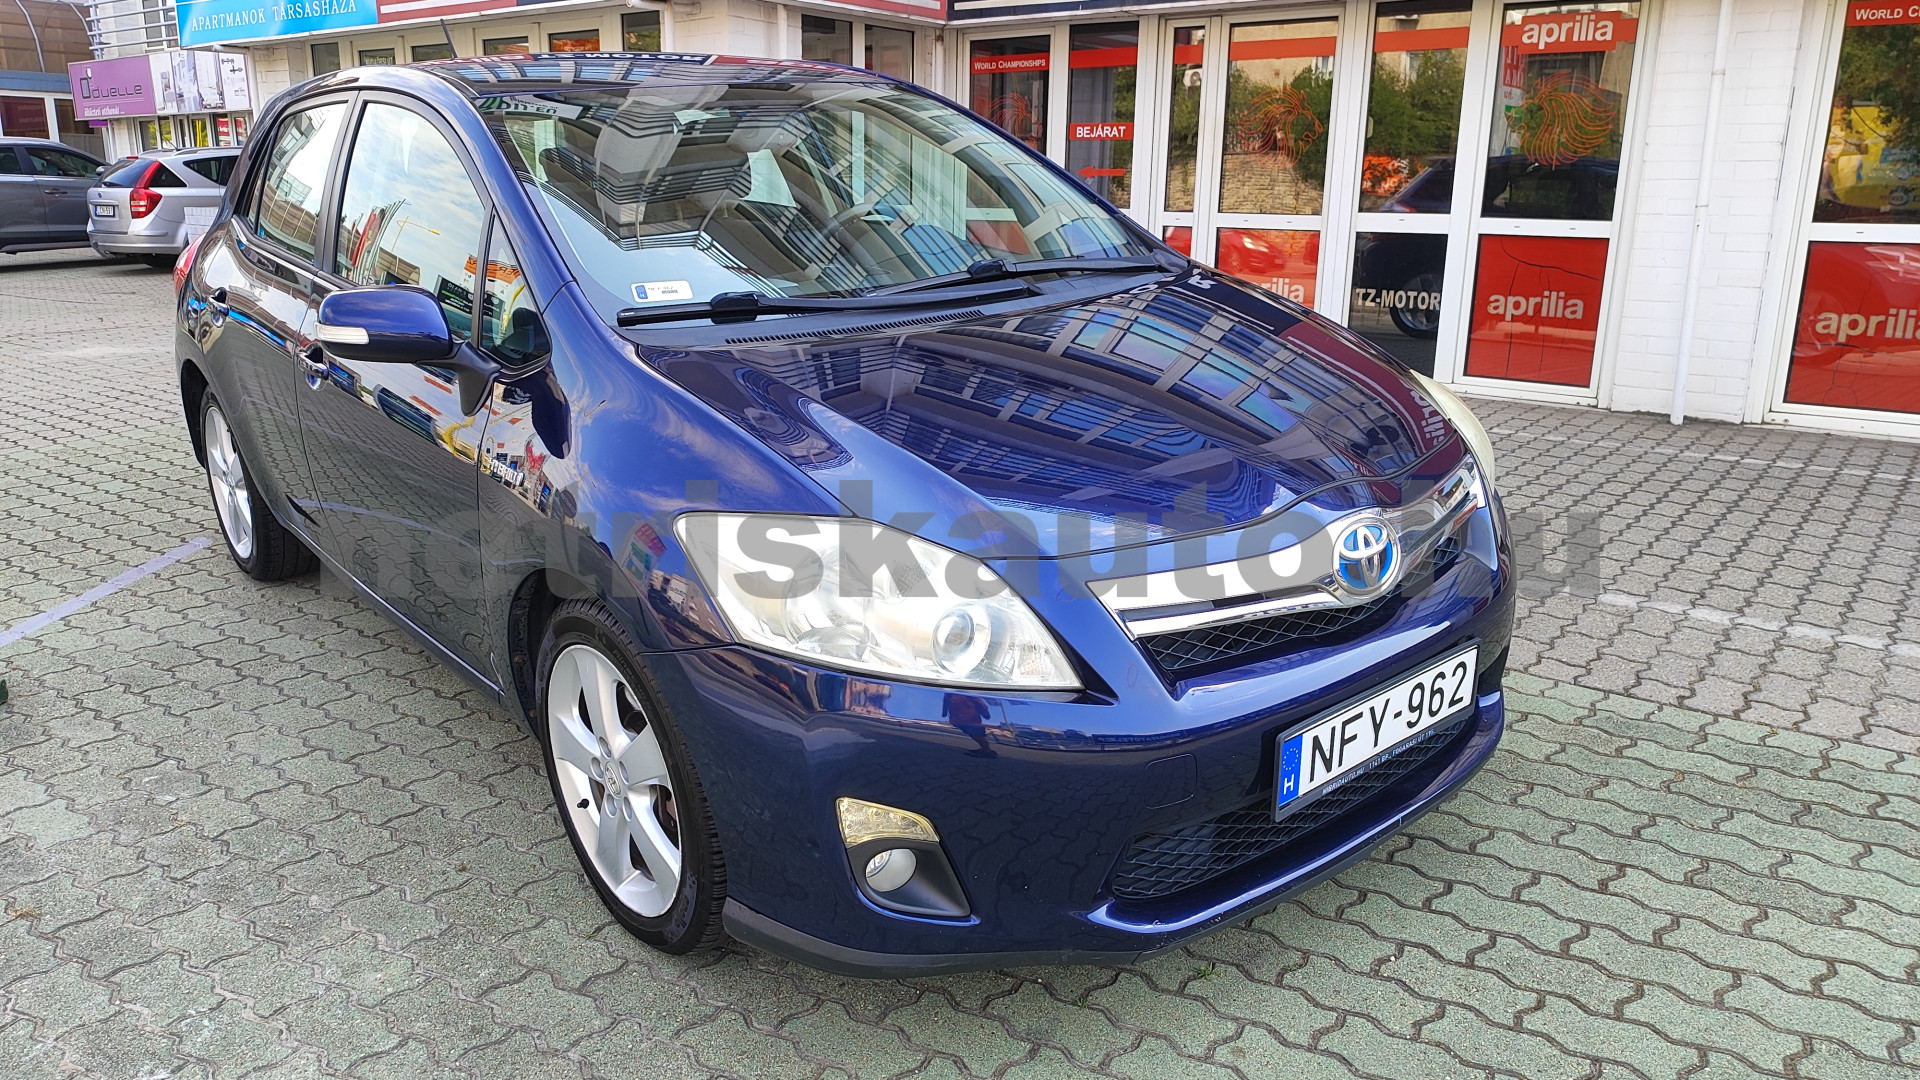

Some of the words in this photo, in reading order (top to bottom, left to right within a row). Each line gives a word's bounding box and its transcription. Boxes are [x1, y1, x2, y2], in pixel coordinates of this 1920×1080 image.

[191, 8, 266, 32] APARTMANOK
[1855, 8, 1903, 20] WORLD
[1908, 5, 1920, 18] C
[1521, 14, 1614, 50] aprilia
[974, 61, 996, 70] WORLD
[998, 59, 1046, 69] CHAMPIONSHIPS
[1076, 123, 1126, 138] BEJÁRAT
[1260, 277, 1304, 303] rilia
[1355, 287, 1441, 311] TZ-MOTOR
[1486, 290, 1584, 321] aprilia
[1309, 661, 1468, 783] NFY-962
